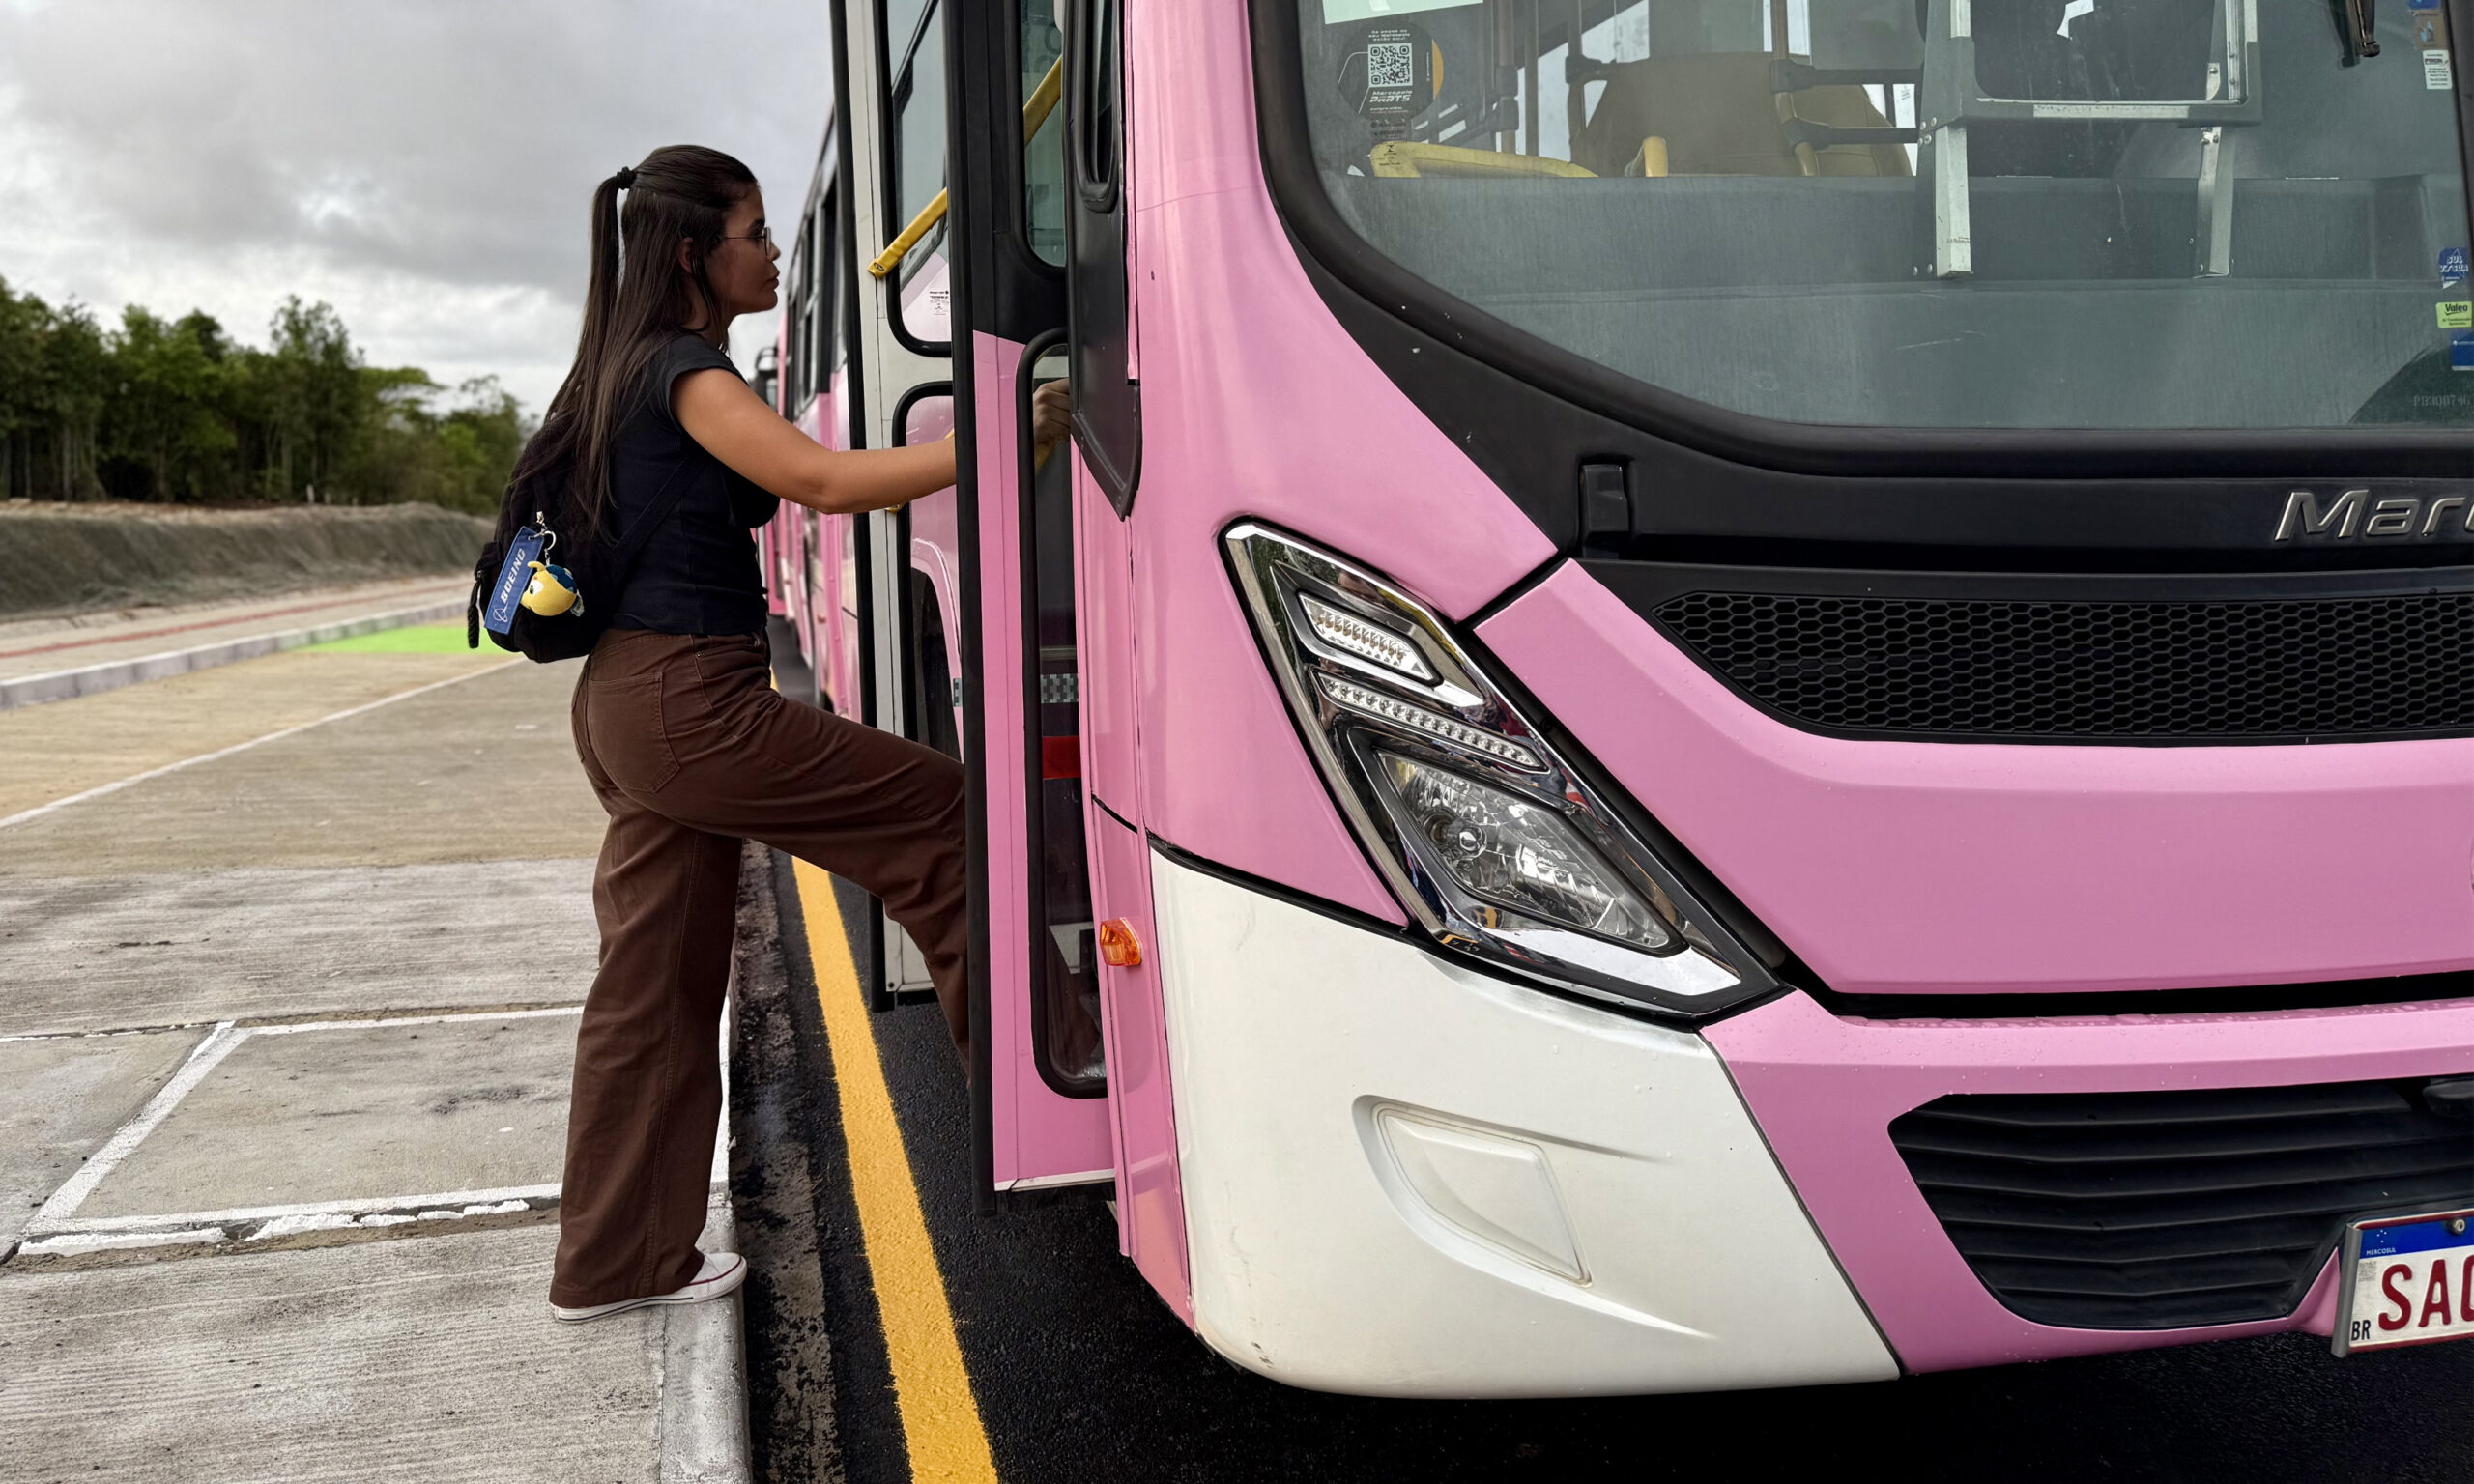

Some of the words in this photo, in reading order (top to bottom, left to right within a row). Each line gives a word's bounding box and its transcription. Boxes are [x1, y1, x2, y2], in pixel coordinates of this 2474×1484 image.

[1369, 94, 1412, 103] PARTS
[2445, 303, 2468, 312] Valeo
[2274, 489, 2474, 541] Mar
[500, 548, 526, 604] BOEING
[2366, 1247, 2397, 1256] MERCOSUL
[2350, 1319, 2371, 1341] BR
